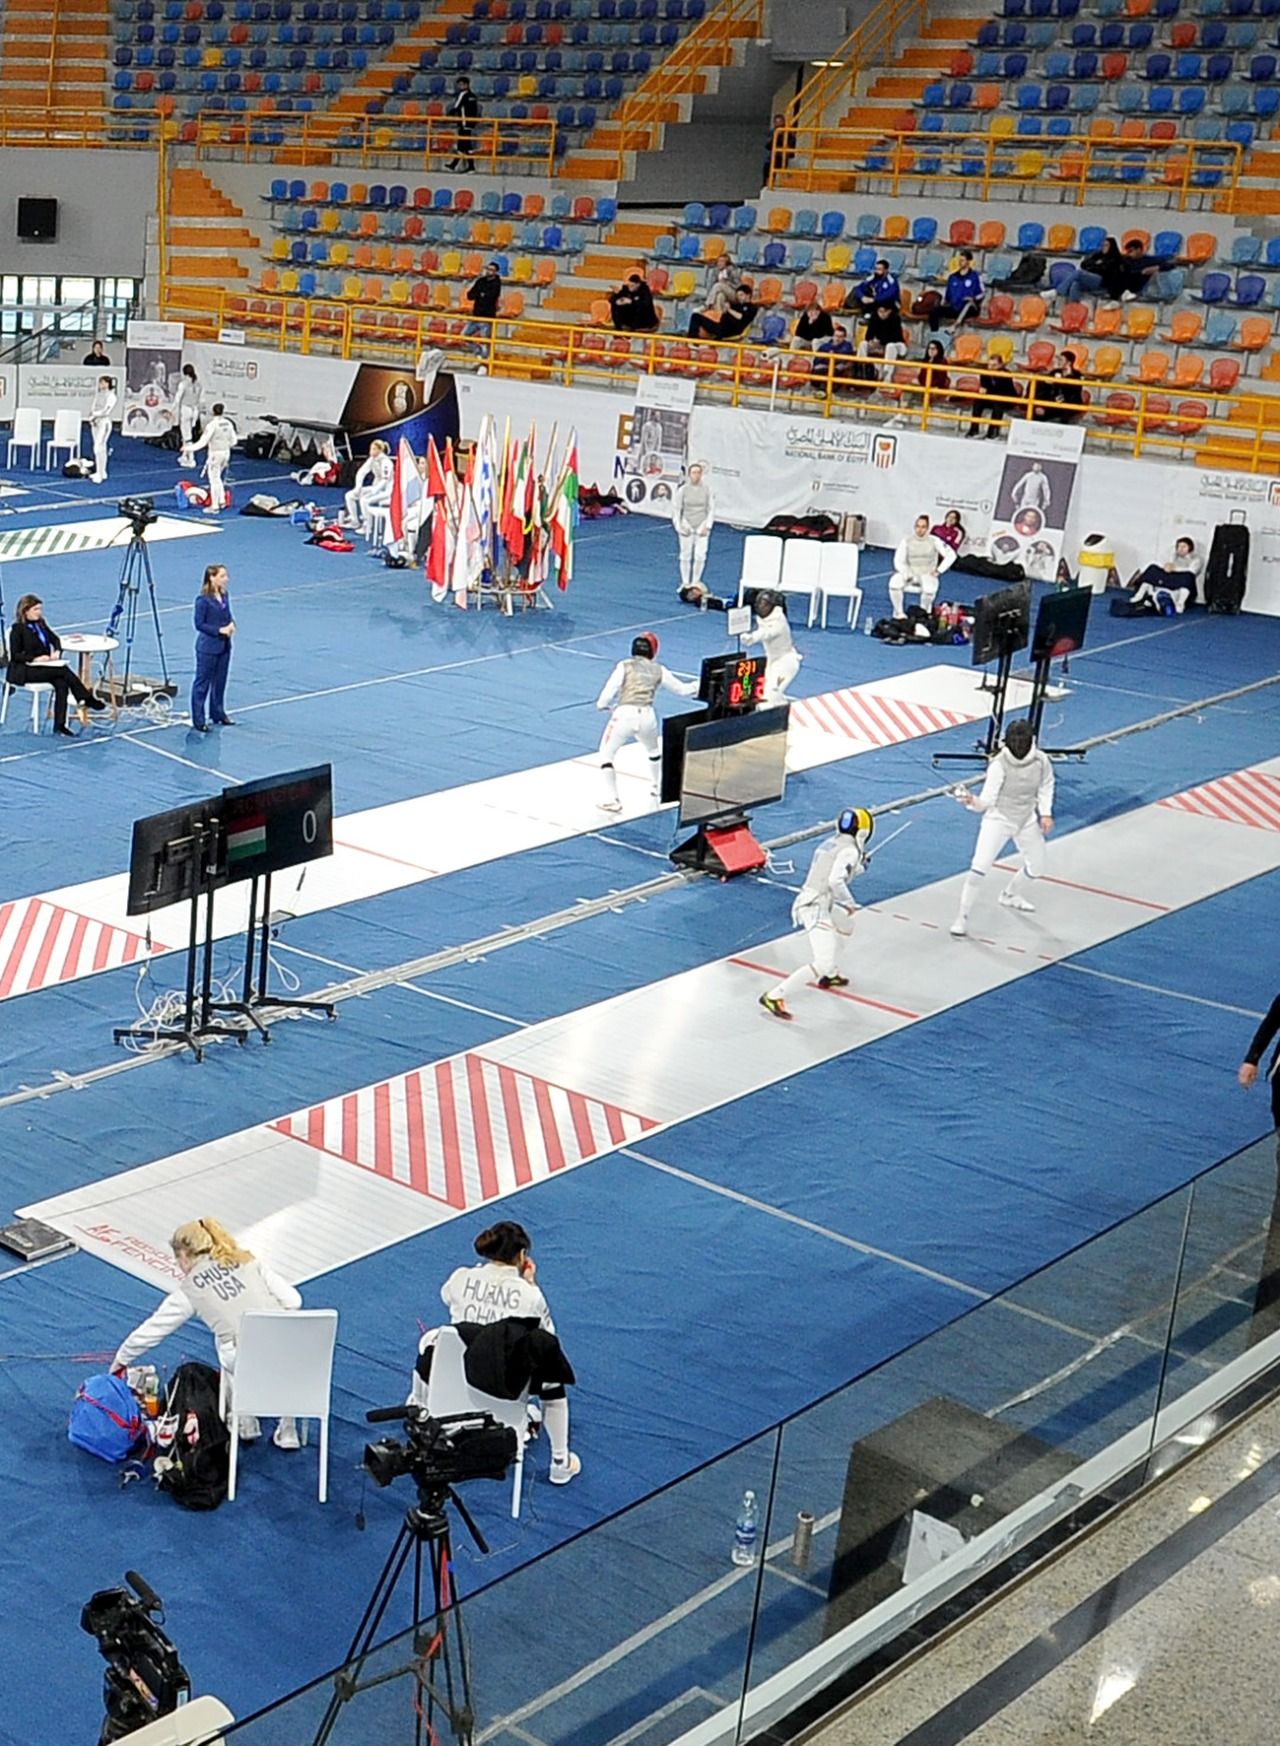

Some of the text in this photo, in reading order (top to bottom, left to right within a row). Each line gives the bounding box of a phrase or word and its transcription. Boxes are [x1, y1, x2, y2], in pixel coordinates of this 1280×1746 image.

[302, 809, 318, 844] 0
[111, 1240, 187, 1281] FENCIN
[212, 1275, 247, 1302] USA
[463, 1277, 522, 1310] HUANG
